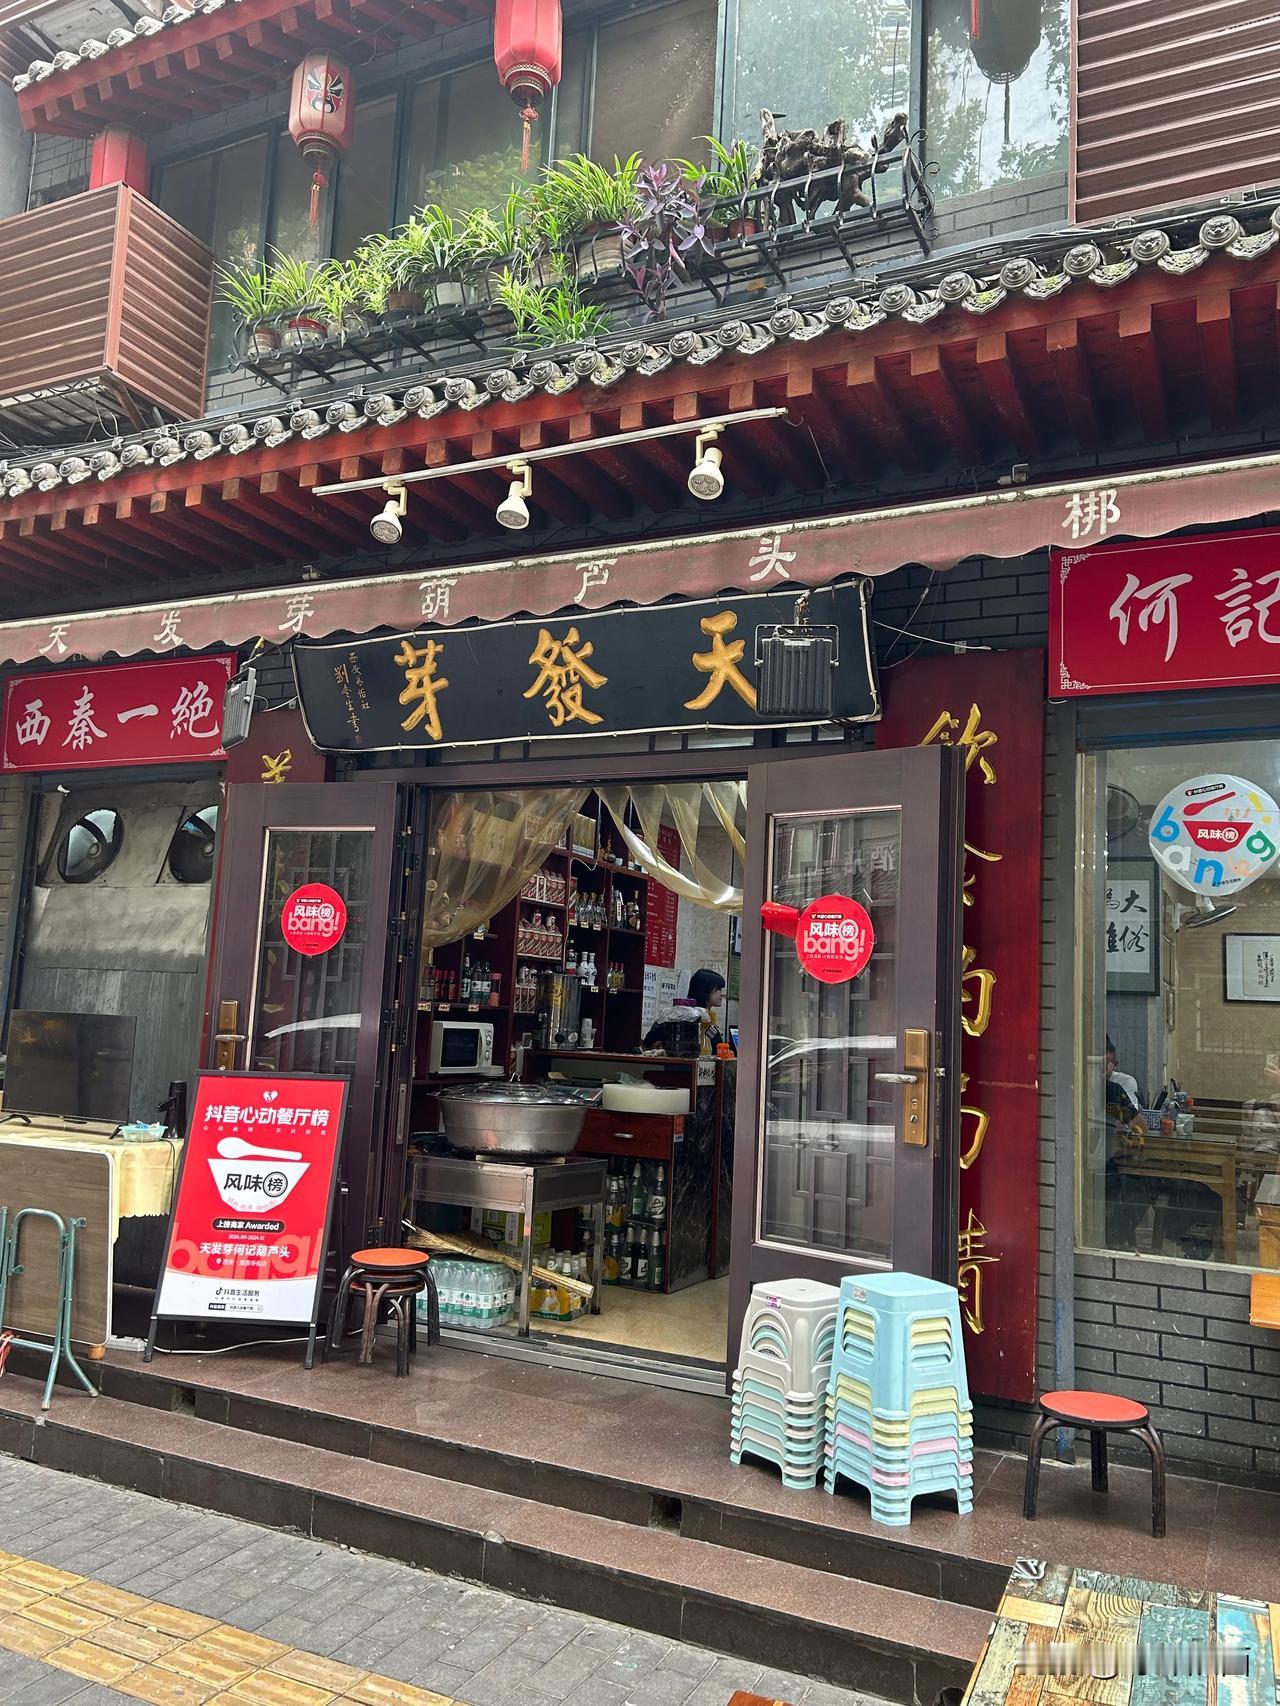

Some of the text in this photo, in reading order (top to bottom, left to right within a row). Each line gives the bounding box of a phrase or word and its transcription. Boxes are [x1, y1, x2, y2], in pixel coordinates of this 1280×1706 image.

[1198, 828, 1237, 841] 风味榜
[294, 904, 333, 918] 风味榜
[288, 912, 340, 937] bang!
[810, 921, 857, 939] 风味榜
[804, 929, 866, 961] bang!
[204, 1104, 330, 1127] 抖音心动餐厅榜
[224, 1172, 286, 1195] 风味榜
[245, 1221, 279, 1231] Awarded
[200, 1242, 290, 1258] 天发芽何记葫芦头
